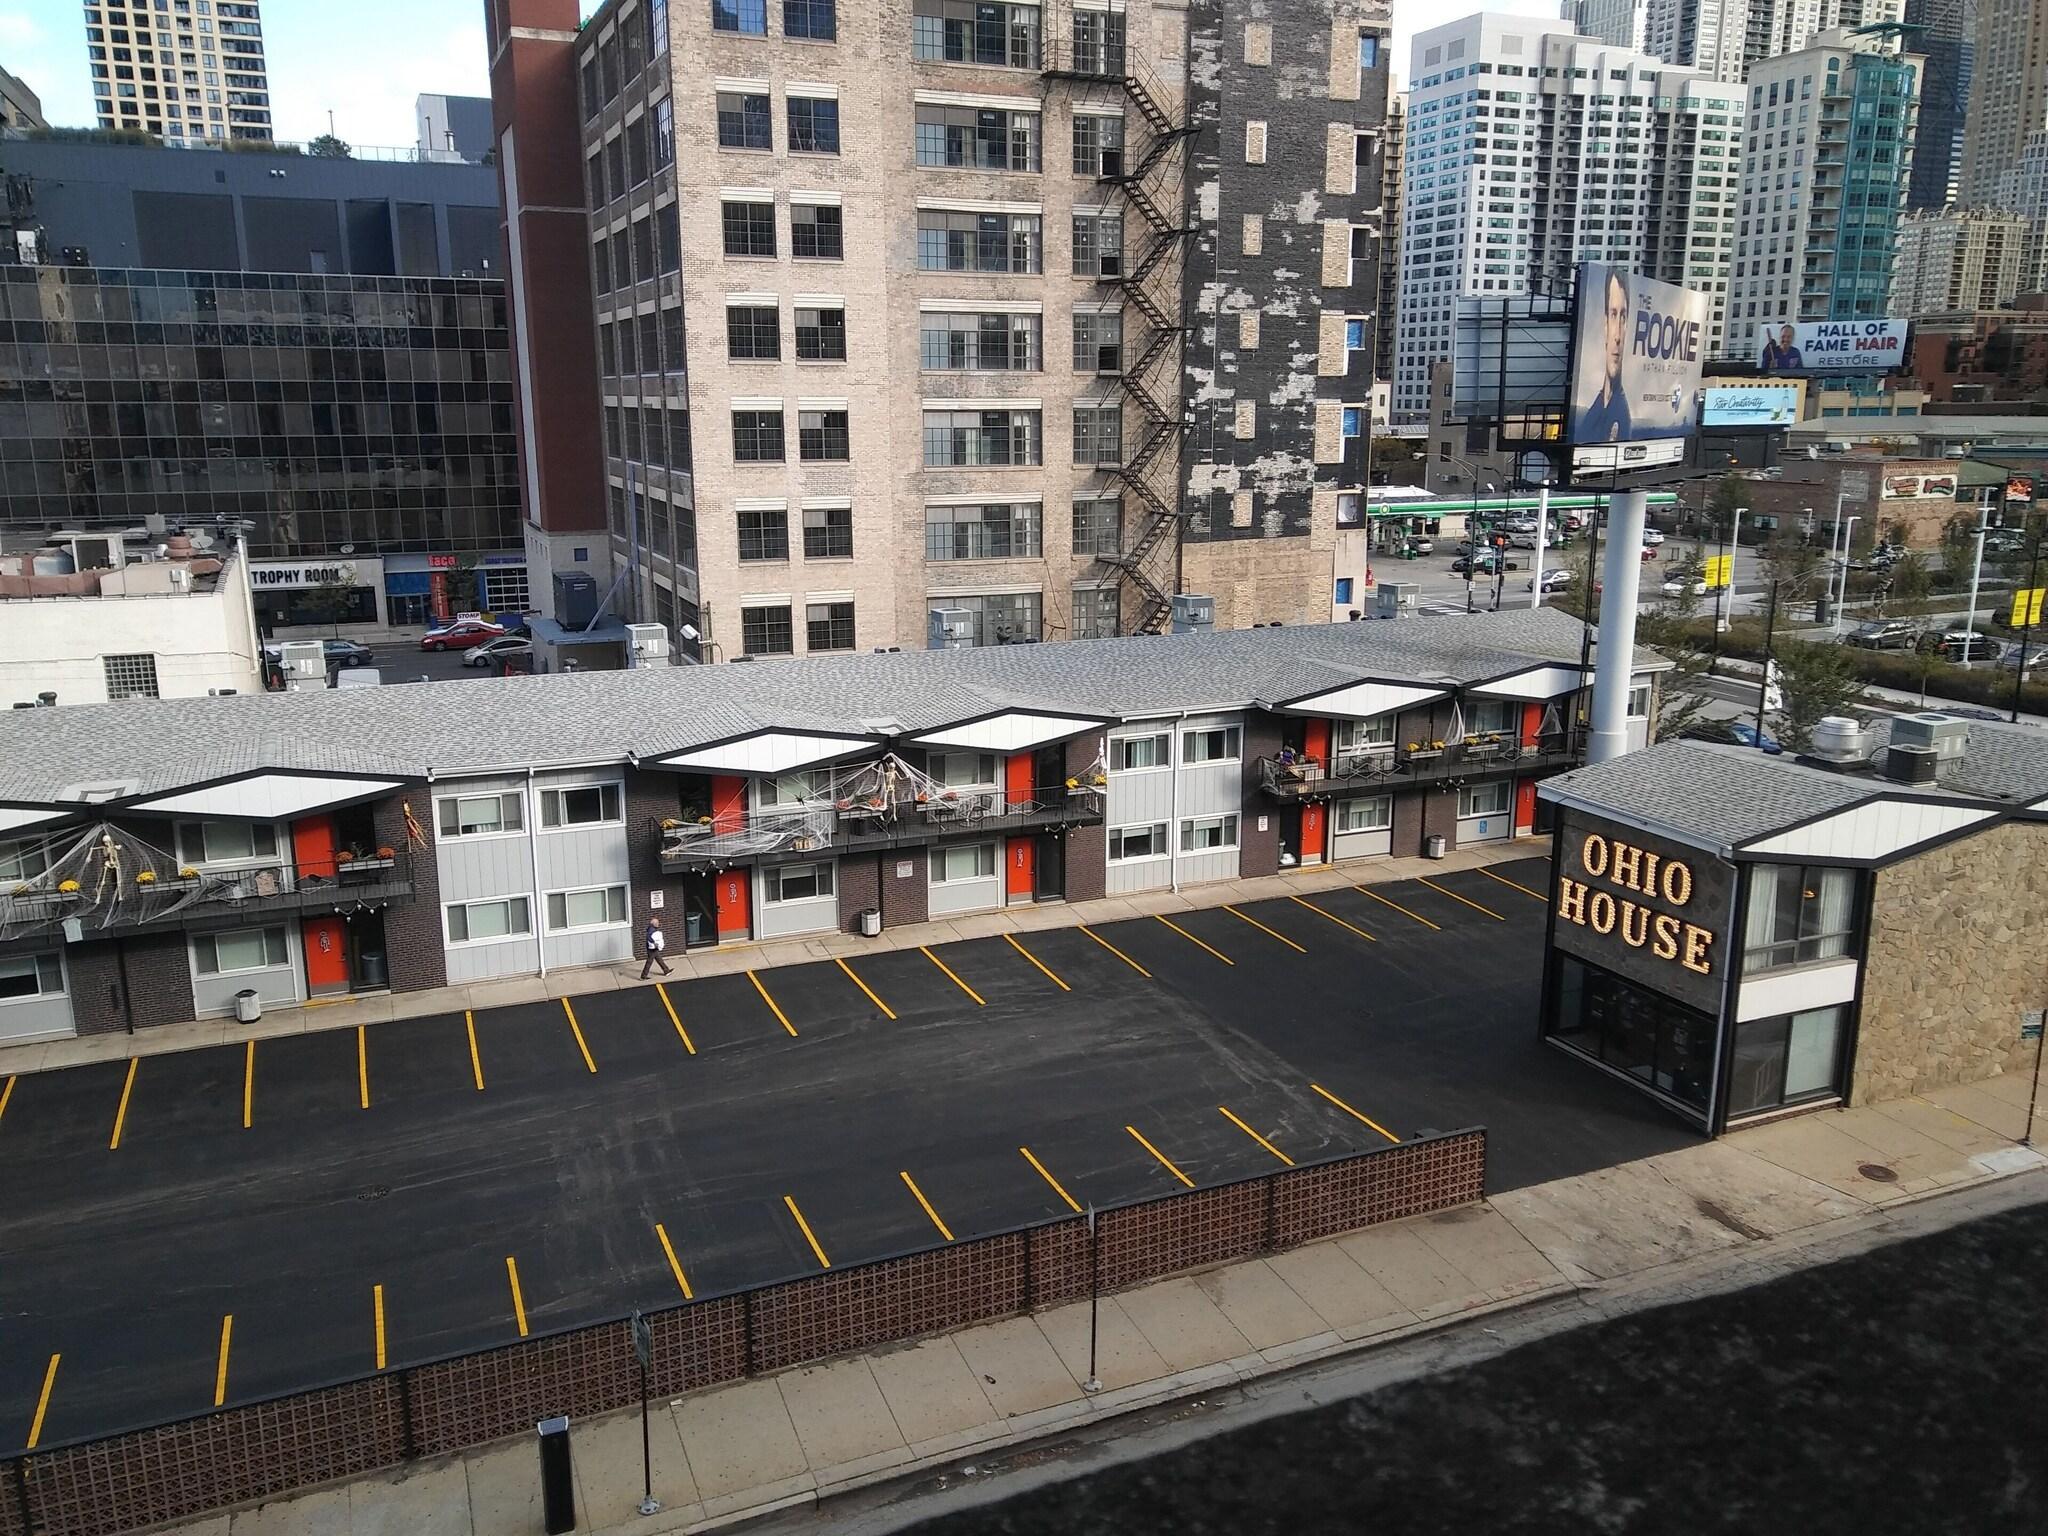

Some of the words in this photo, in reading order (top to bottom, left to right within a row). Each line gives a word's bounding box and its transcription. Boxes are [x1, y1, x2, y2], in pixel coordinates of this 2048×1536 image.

[1638, 293, 1652, 310] THE
[1632, 310, 1700, 361] ROOKIE
[1817, 324, 1859, 337] HALL
[1865, 322, 1888, 335] OF
[1804, 339, 1850, 352] FAME
[1855, 336, 1898, 351] HAIR
[1818, 353, 1880, 366] RESTORE
[251, 569, 300, 585] TROPHY
[304, 568, 340, 584] ROOM
[458, 612, 480, 620] STOMP
[1583, 834, 1692, 906] OHIO
[1558, 877, 1713, 975] HOUSE
